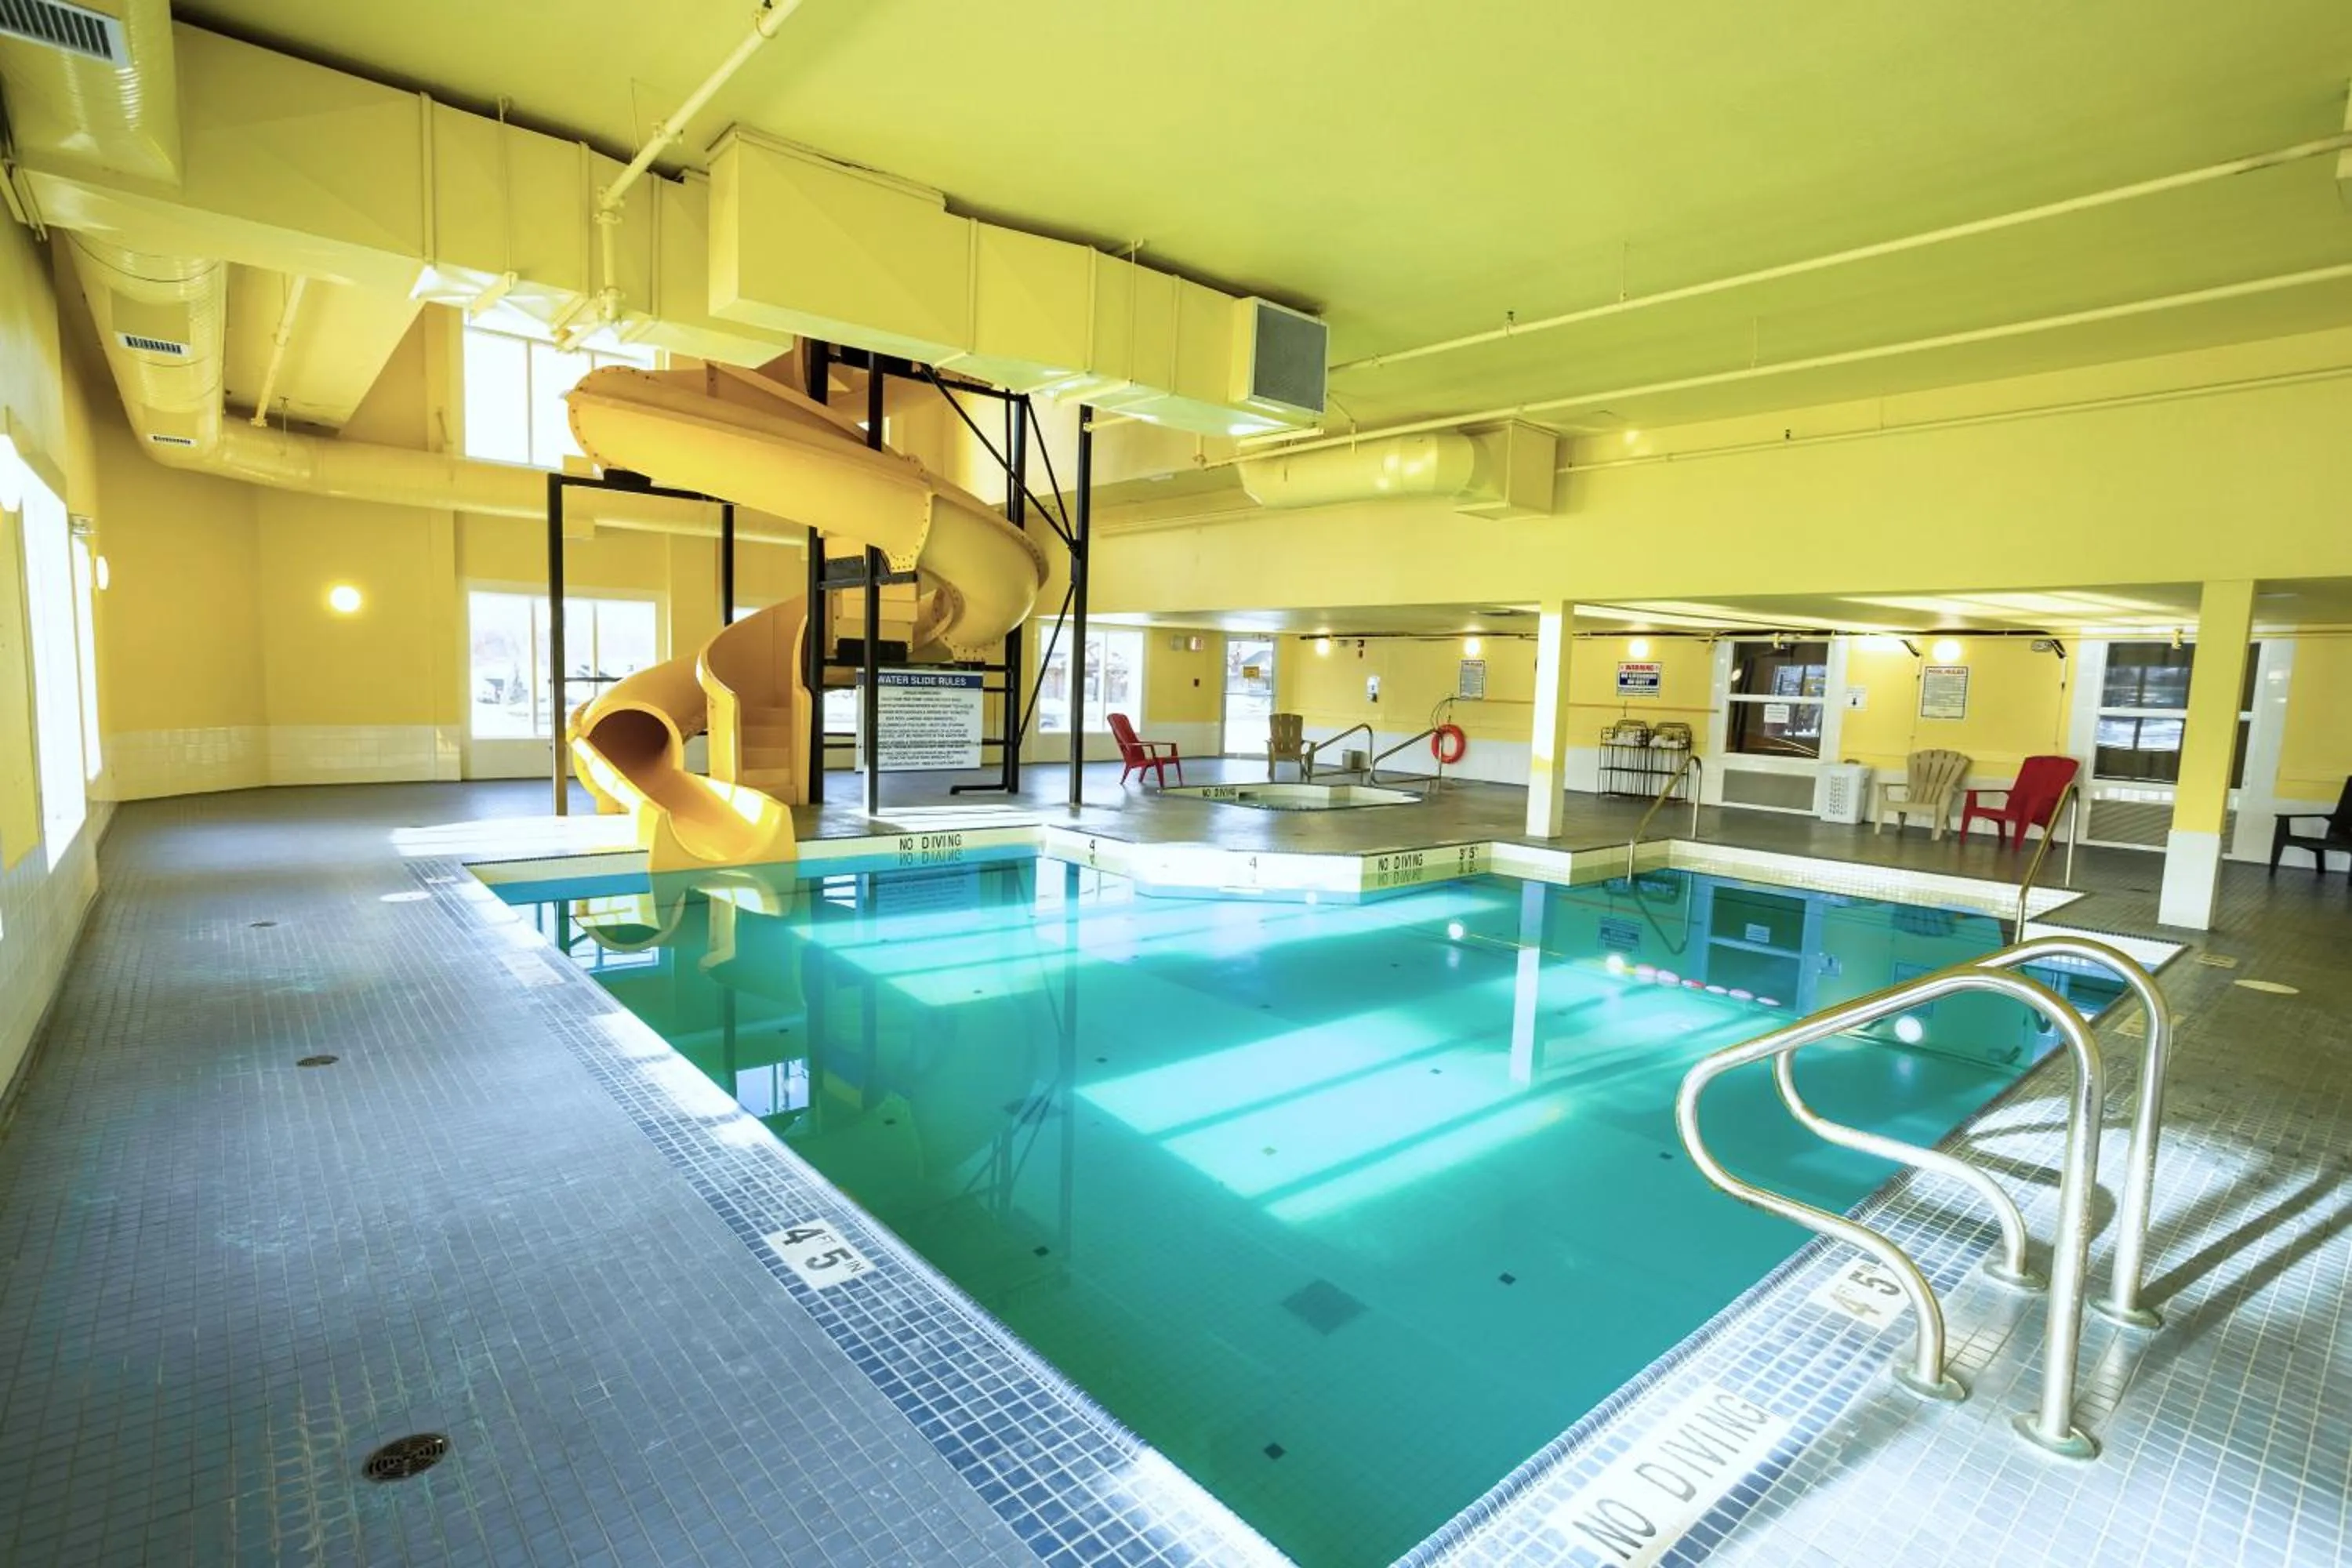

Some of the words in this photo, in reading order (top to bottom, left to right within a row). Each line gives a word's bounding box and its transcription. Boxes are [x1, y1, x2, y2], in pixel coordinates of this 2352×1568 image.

[877, 675, 909, 684] WATER
[910, 676, 936, 685] SLIDE
[938, 677, 967, 686] RULES
[1202, 788, 1211, 797] NO
[899, 837, 913, 851] NO
[921, 833, 962, 849] DIVING
[1377, 858, 1388, 872] NO
[1393, 853, 1423, 869] DIVING
[783, 1229, 825, 1245] 4
[805, 1248, 853, 1270] 5
[1848, 1270, 1901, 1295] 5
[1572, 1498, 1657, 1560] NO
[1634, 1393, 1770, 1504] DIVING
